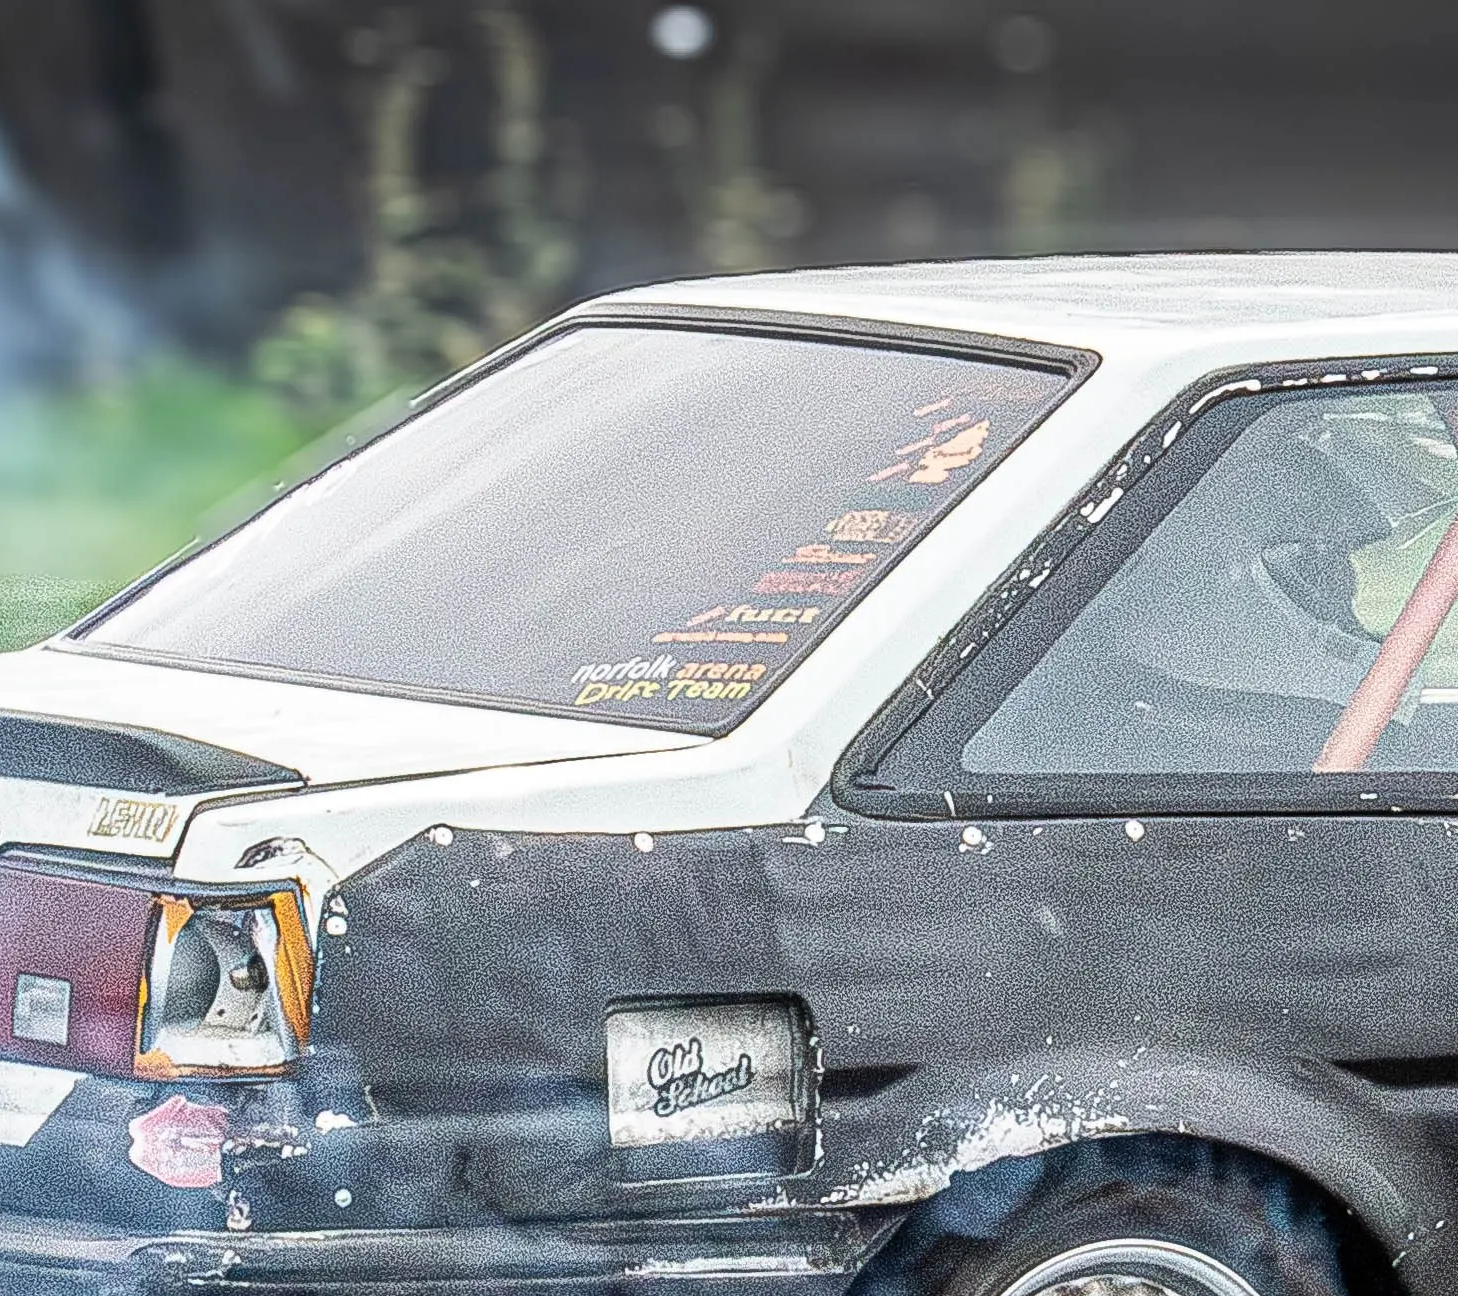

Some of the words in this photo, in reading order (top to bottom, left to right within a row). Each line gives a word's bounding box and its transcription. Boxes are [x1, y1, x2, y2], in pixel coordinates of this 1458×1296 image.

[571, 654, 676, 683] norfolk
[676, 662, 767, 682] arena
[648, 1037, 704, 1090] Old
[653, 1054, 755, 1118] School
